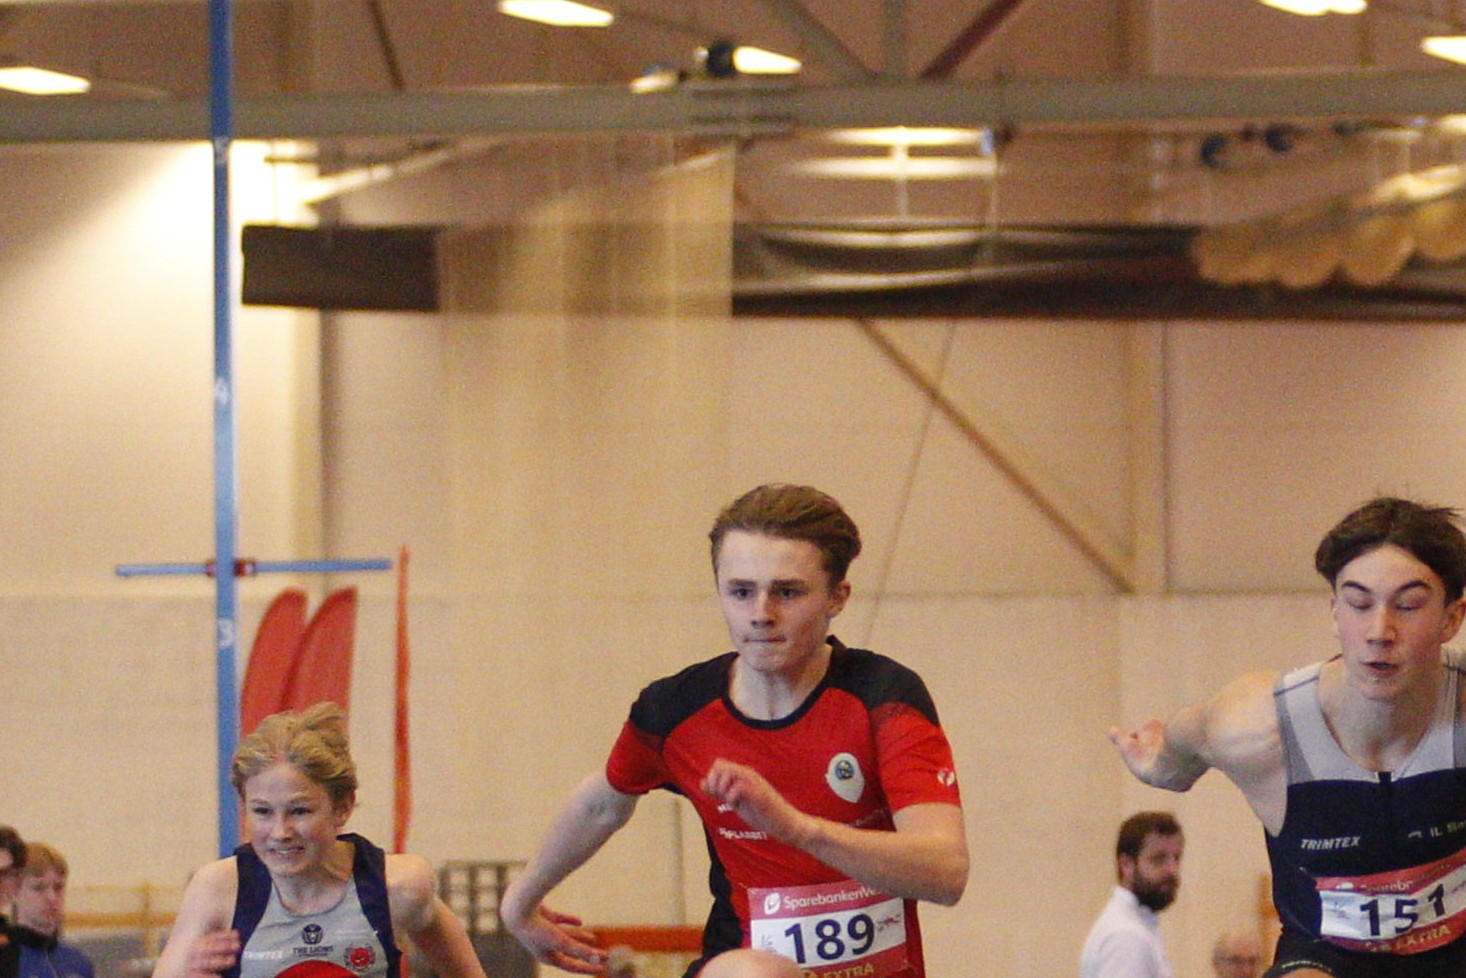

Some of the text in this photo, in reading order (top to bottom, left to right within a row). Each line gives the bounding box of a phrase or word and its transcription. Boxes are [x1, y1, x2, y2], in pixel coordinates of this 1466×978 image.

[1299, 835, 1361, 851] TRIMTEX
[783, 885, 877, 911] SparebankenVe
[1360, 883, 1446, 937] 151
[783, 913, 876, 964] 189
